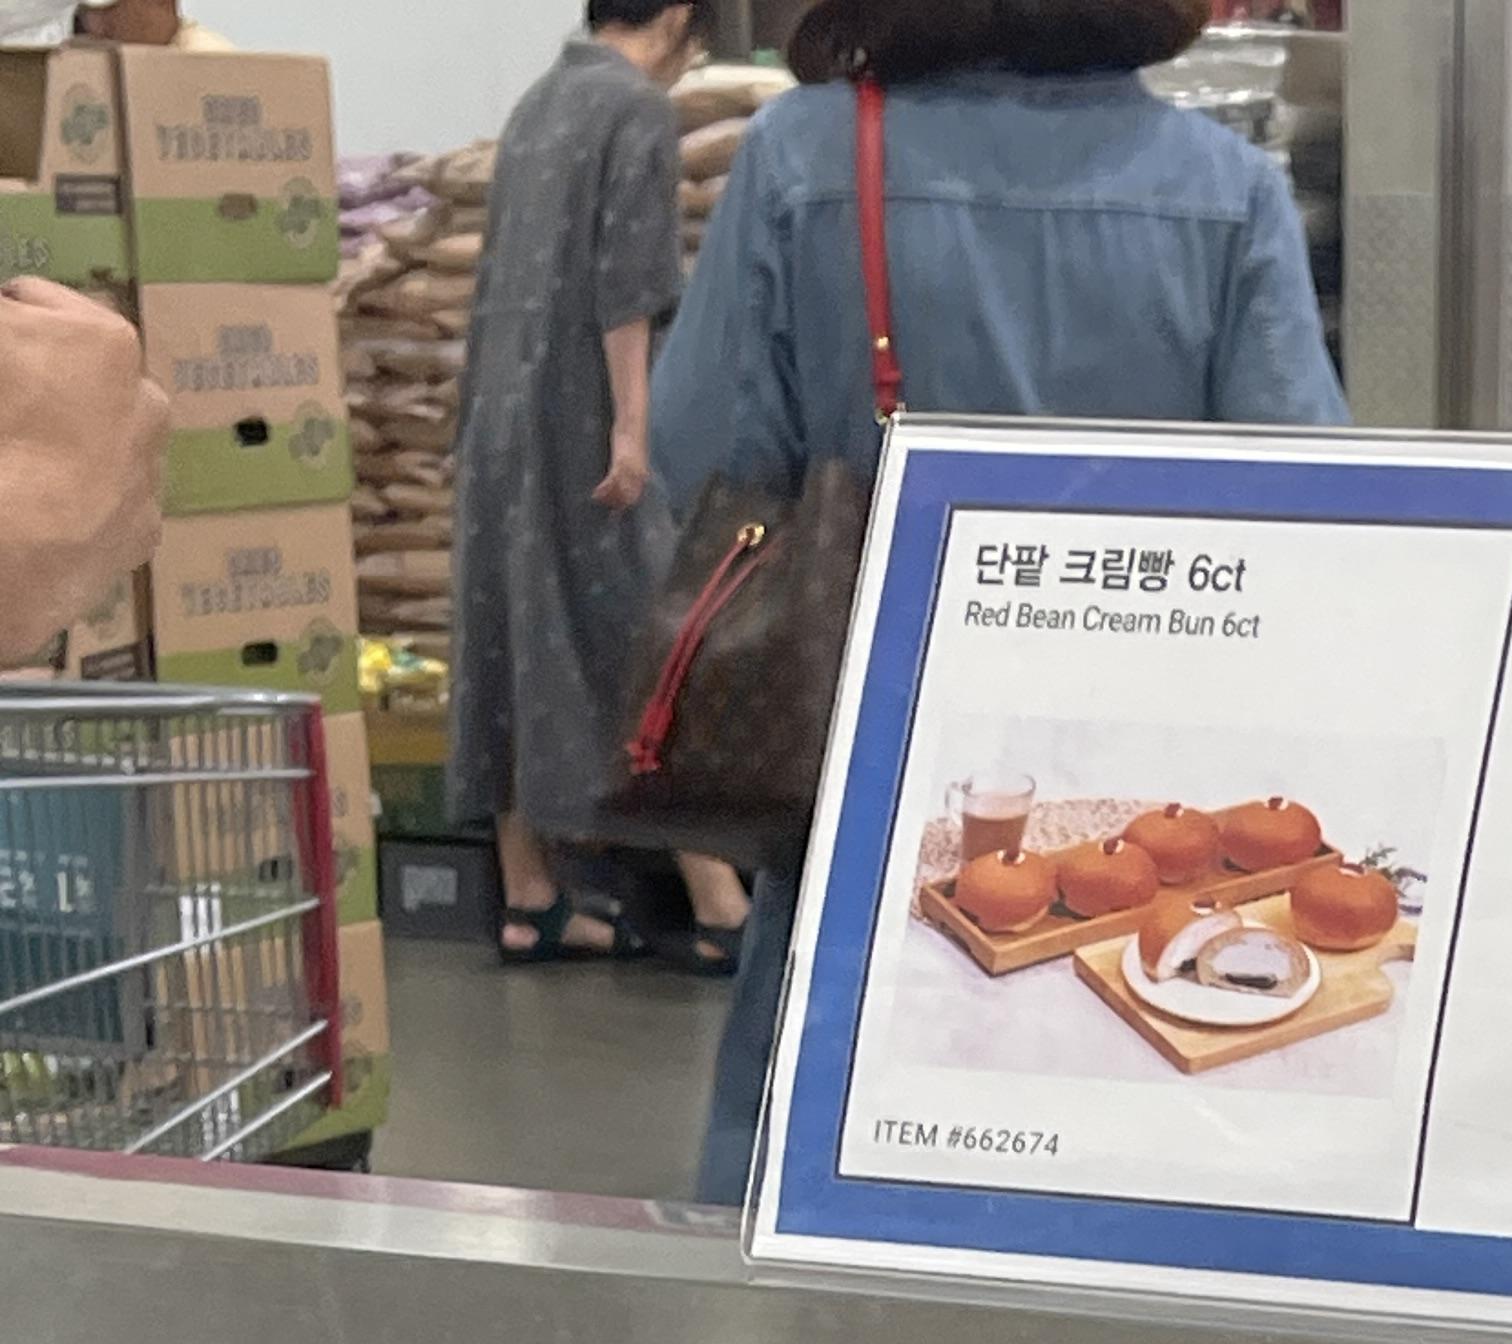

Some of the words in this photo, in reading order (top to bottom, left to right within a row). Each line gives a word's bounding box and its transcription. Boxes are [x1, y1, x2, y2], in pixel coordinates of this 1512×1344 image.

[975, 543, 1050, 588] 단팥
[1059, 547, 1175, 593] 크림빵
[1187, 554, 1247, 593] 6ct
[964, 600, 1011, 627] Red
[1015, 602, 1076, 630] Bean
[1082, 606, 1162, 632] Cream
[1167, 609, 1215, 636] Bun
[1221, 613, 1261, 638] 6ct
[874, 1119, 939, 1147] ITEM
[947, 1127, 1060, 1156] #662674
